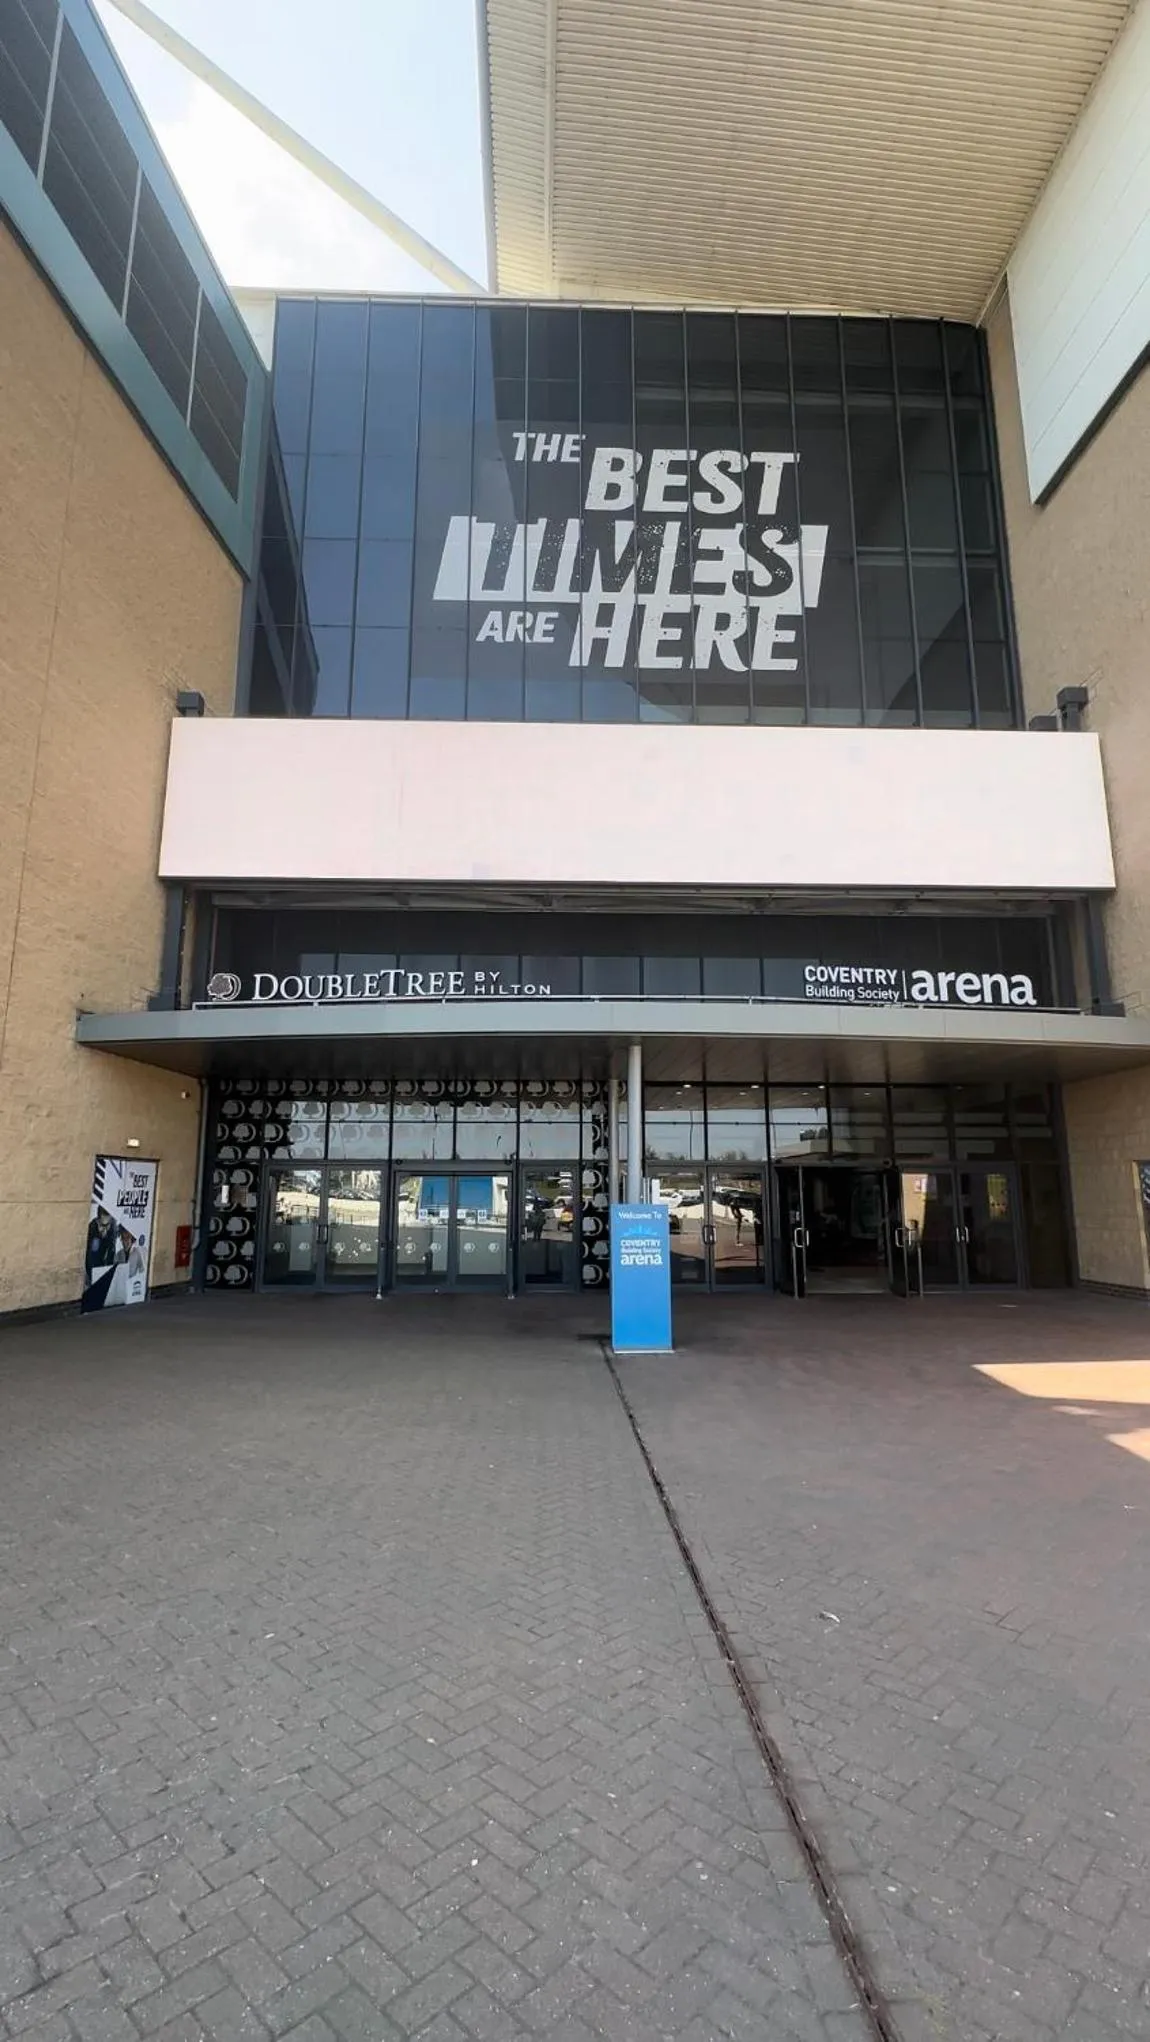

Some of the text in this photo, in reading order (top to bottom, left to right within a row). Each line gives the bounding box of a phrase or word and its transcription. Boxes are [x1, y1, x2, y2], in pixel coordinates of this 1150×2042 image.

[512, 432, 800, 515] THE BEST
[472, 518, 802, 599] TIMES
[475, 601, 802, 671] ARE HERE
[475, 971, 501, 982] BY
[804, 965, 898, 985] COVENTRY
[474, 984, 552, 995] HILTON
[805, 985, 900, 1002] Building Society
[911, 970, 1036, 1006] arena
[618, 1211, 662, 1219] Welcome To
[620, 1239, 661, 1247] COVENTRY
[620, 1254, 663, 1265] arena
